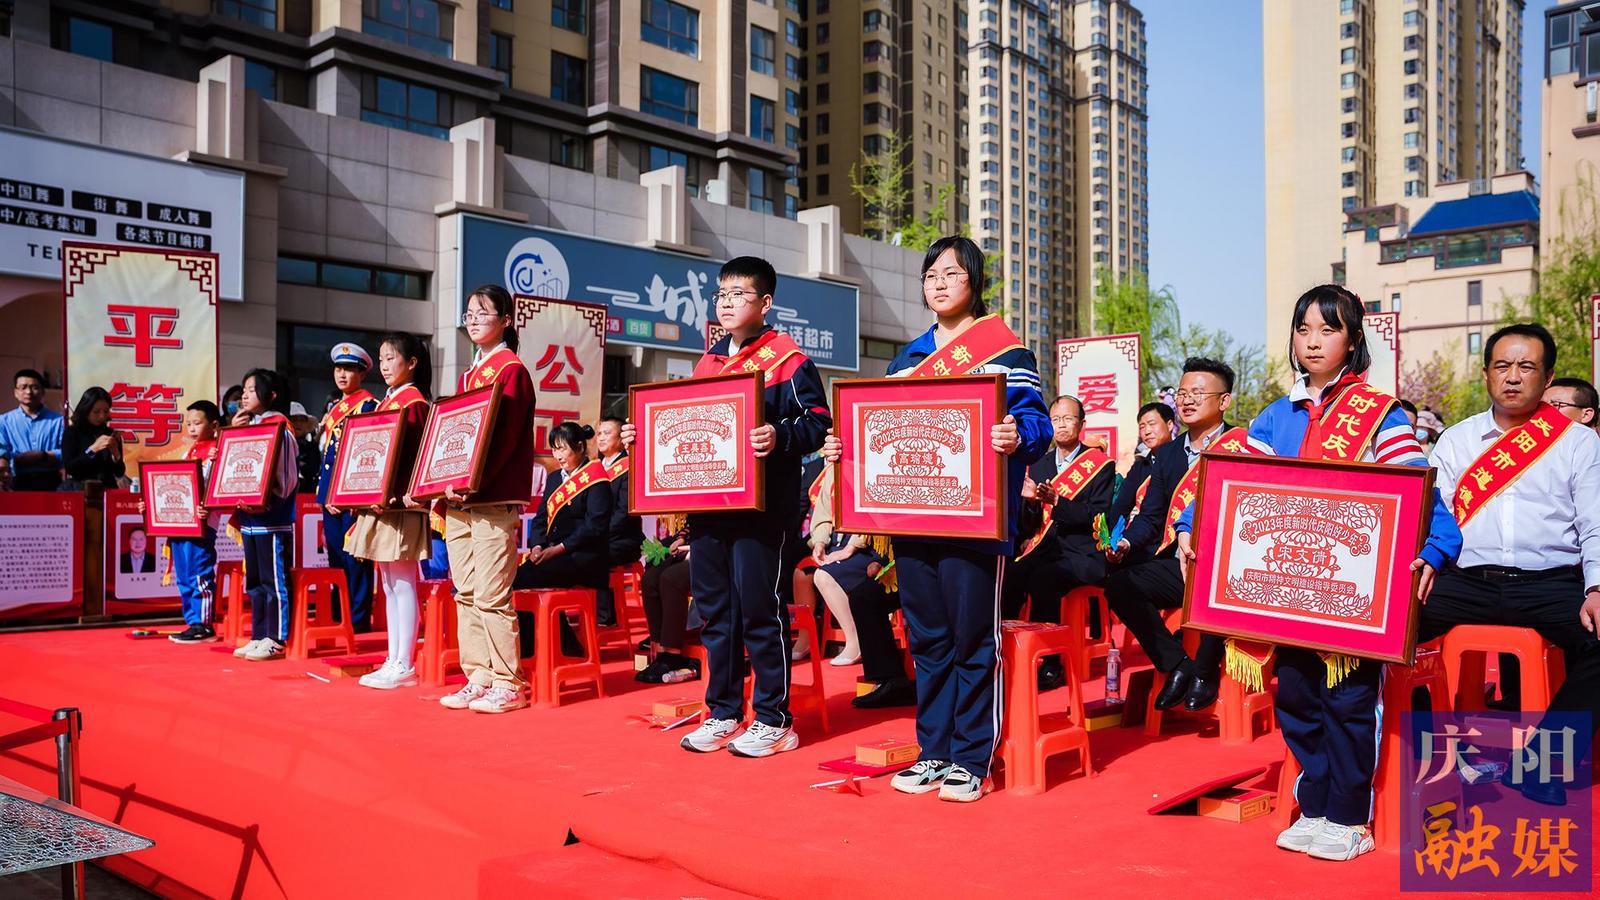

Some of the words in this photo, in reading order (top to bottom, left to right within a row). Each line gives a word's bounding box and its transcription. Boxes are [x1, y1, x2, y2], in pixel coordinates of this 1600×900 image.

[1, 181, 49, 202] 中国舞
[1, 207, 85, 233] 中/高考集训
[159, 207, 200, 225] 成人舞
[124, 226, 205, 248] 各类节目编排
[921, 345, 972, 376] 新时
[104, 304, 184, 446] 平等
[1321, 385, 1378, 460] 时代庆
[1252, 517, 1359, 546] 2023年度新时代庆阳好少年
[1245, 571, 1355, 595] 庆阳市精神文明建设指导委员会
